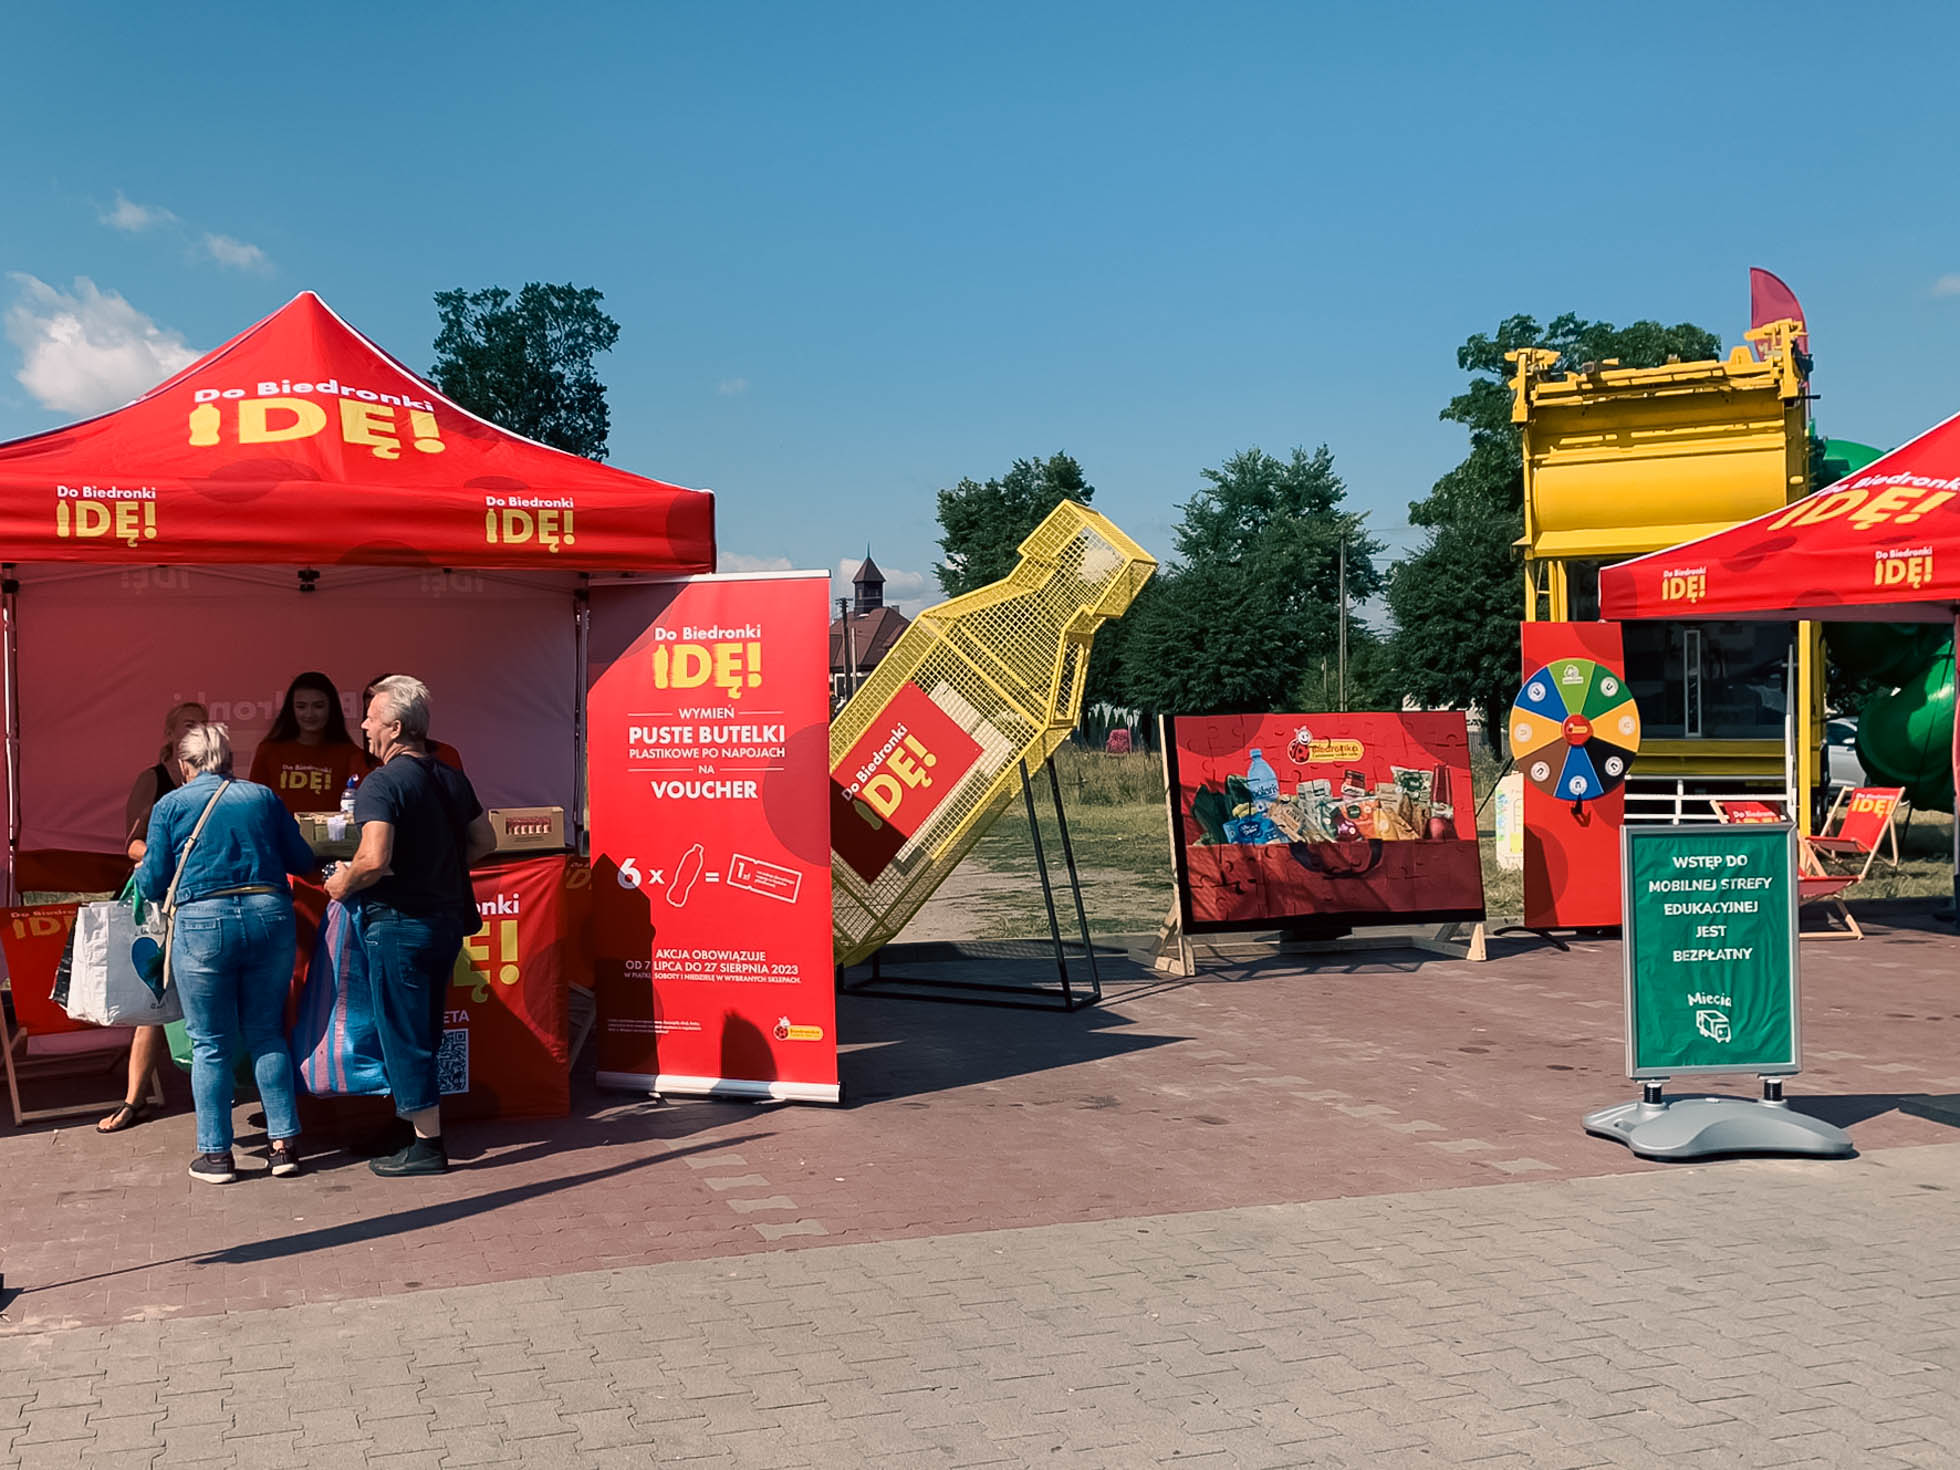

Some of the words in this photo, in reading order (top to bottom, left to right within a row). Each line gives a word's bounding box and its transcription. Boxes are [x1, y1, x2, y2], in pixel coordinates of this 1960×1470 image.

[194, 388, 245, 403] Do
[257, 379, 434, 412] Biedronki
[56, 486, 79, 498] Do
[82, 485, 156, 499] Biedronki
[485, 496, 506, 506] Do
[508, 496, 574, 508] Biedronki
[1875, 550, 1889, 560] Do
[1889, 546, 1933, 558] Biedronki
[654, 627, 677, 641] Do
[682, 624, 761, 641] Biedronki
[678, 704, 735, 719] WYMIEŃ
[628, 727, 693, 744] PUSTE
[699, 725, 785, 744] BUTELKI
[629, 748, 699, 759] PLASTIKOWE
[702, 748, 718, 758] PO
[722, 747, 785, 758] NAPOJACH
[842, 782, 860, 800] Do
[856, 722, 908, 783] Biedronki
[698, 765, 714, 774] NA
[280, 771, 332, 794] IDĘ!
[651, 780, 758, 799] VOUCHER
[1672, 856, 1723, 870] WSTĘP
[1726, 855, 1748, 867] DO
[617, 858, 642, 889] 6
[649, 869, 665, 884] x
[1649, 879, 1717, 892] MOBILNEJ
[1721, 877, 1773, 890] STREFY
[1664, 901, 1758, 915] EDUKACYJNEJ
[1696, 925, 1727, 937] JEST
[655, 949, 690, 960] AKCJA
[692, 950, 766, 962] OBOWIĄZUJE
[1673, 948, 1753, 962] BEZPŁATNY
[625, 960, 642, 970] OD
[644, 960, 651, 970] 7
[654, 961, 683, 972] LIPCA
[684, 962, 701, 972] DO
[704, 963, 717, 973] 27
[719, 963, 769, 974] SIERPNIA
[771, 964, 799, 975] 2023
[654, 972, 680, 980] SOBOTY
[724, 975, 767, 983] WYBRANYCH
[1687, 992, 1732, 1007] Miecia
